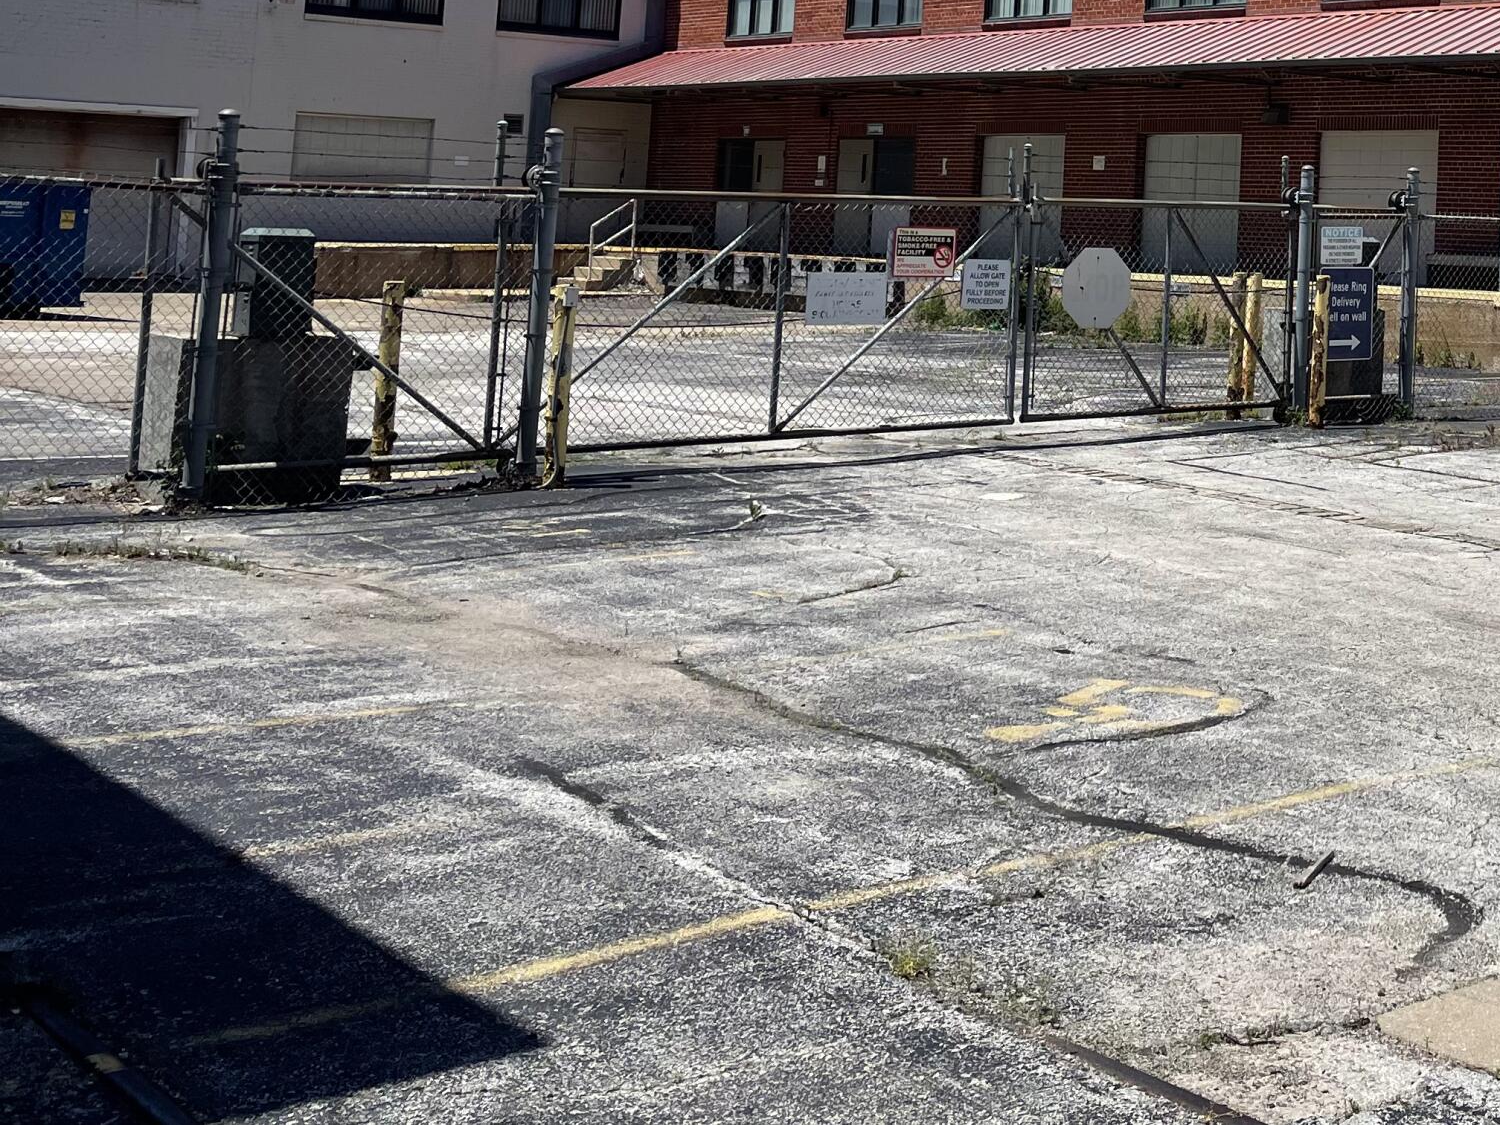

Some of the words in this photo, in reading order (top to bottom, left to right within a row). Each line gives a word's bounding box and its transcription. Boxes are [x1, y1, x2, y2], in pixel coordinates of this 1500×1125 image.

[1325, 229, 1360, 237] NOTICE
[1331, 281, 1350, 292] lease
[1351, 281, 1367, 295] Ring
[1331, 296, 1361, 309] Delivery
[1329, 311, 1339, 322] ell
[1340, 313, 1350, 322] on
[1351, 311, 1367, 321] wall
